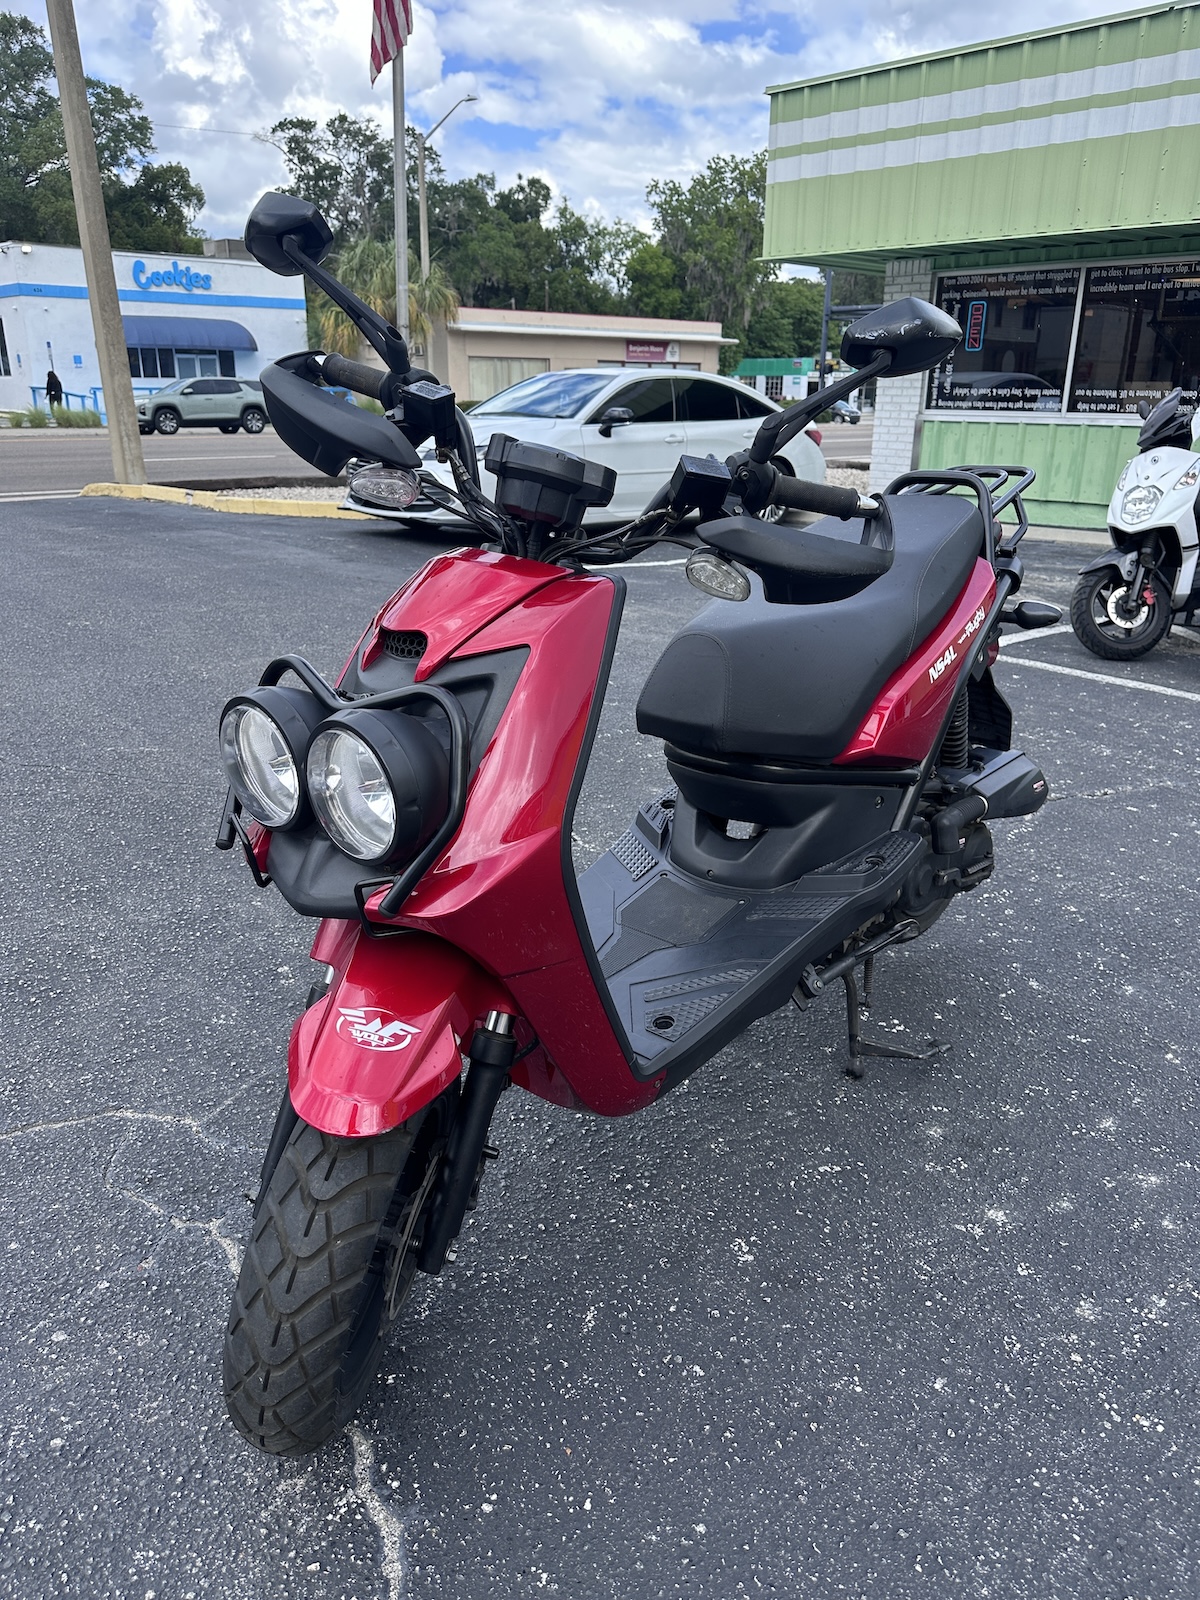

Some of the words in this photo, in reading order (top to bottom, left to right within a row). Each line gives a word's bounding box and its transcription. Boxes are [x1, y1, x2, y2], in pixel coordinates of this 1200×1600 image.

[132, 260, 212, 292] Cookies
[944, 277, 956, 286] From
[957, 275, 984, 285] 2000-2004
[998, 274, 1006, 283] the
[1007, 273, 1015, 282] UF
[1016, 272, 1035, 282] student
[1036, 271, 1046, 280] that
[1047, 270, 1073, 281] struggled
[1090, 269, 1100, 279] get
[1101, 269, 1108, 277] to
[1125, 267, 1128, 276] I
[1129, 267, 1144, 276] went
[1144, 266, 1151, 274] to
[1152, 264, 1162, 274] the
[1163, 264, 1174, 273] bus
[1175, 263, 1190, 274] stop.
[942, 290, 962, 300] parking.
[962, 288, 989, 298] Gainesville
[990, 288, 1005, 296] would
[1021, 287, 1028, 296] be
[1028, 286, 1037, 295] the
[1055, 285, 1068, 294] Now
[1068, 287, 1078, 295] my
[1090, 282, 1118, 293] incredible
[1119, 281, 1134, 292] team
[1134, 281, 1147, 290] and
[1163, 281, 1174, 289] out
[968, 304, 983, 348] OPEN
[629, 344, 650, 352] Benjamin
[953, 387, 970, 396] Safely!
[978, 388, 991, 396] Scoot
[997, 388, 1010, 397] Calm
[1011, 388, 1022, 397] Stay
[1024, 387, 1040, 397] family.
[1093, 389, 1117, 398] Welcome
[1136, 390, 1161, 399] Welcome
[938, 399, 953, 408] having
[954, 401, 972, 409] without
[973, 401, 984, 409] class
[985, 401, 998, 410] from
[1014, 400, 1023, 409] get
[1024, 401, 1045, 410] students
[1046, 401, 1061, 410] ollege
[1077, 401, 1090, 412] help
[928, 646, 957, 684] NS4L
[351, 1028, 390, 1045] WOLF
